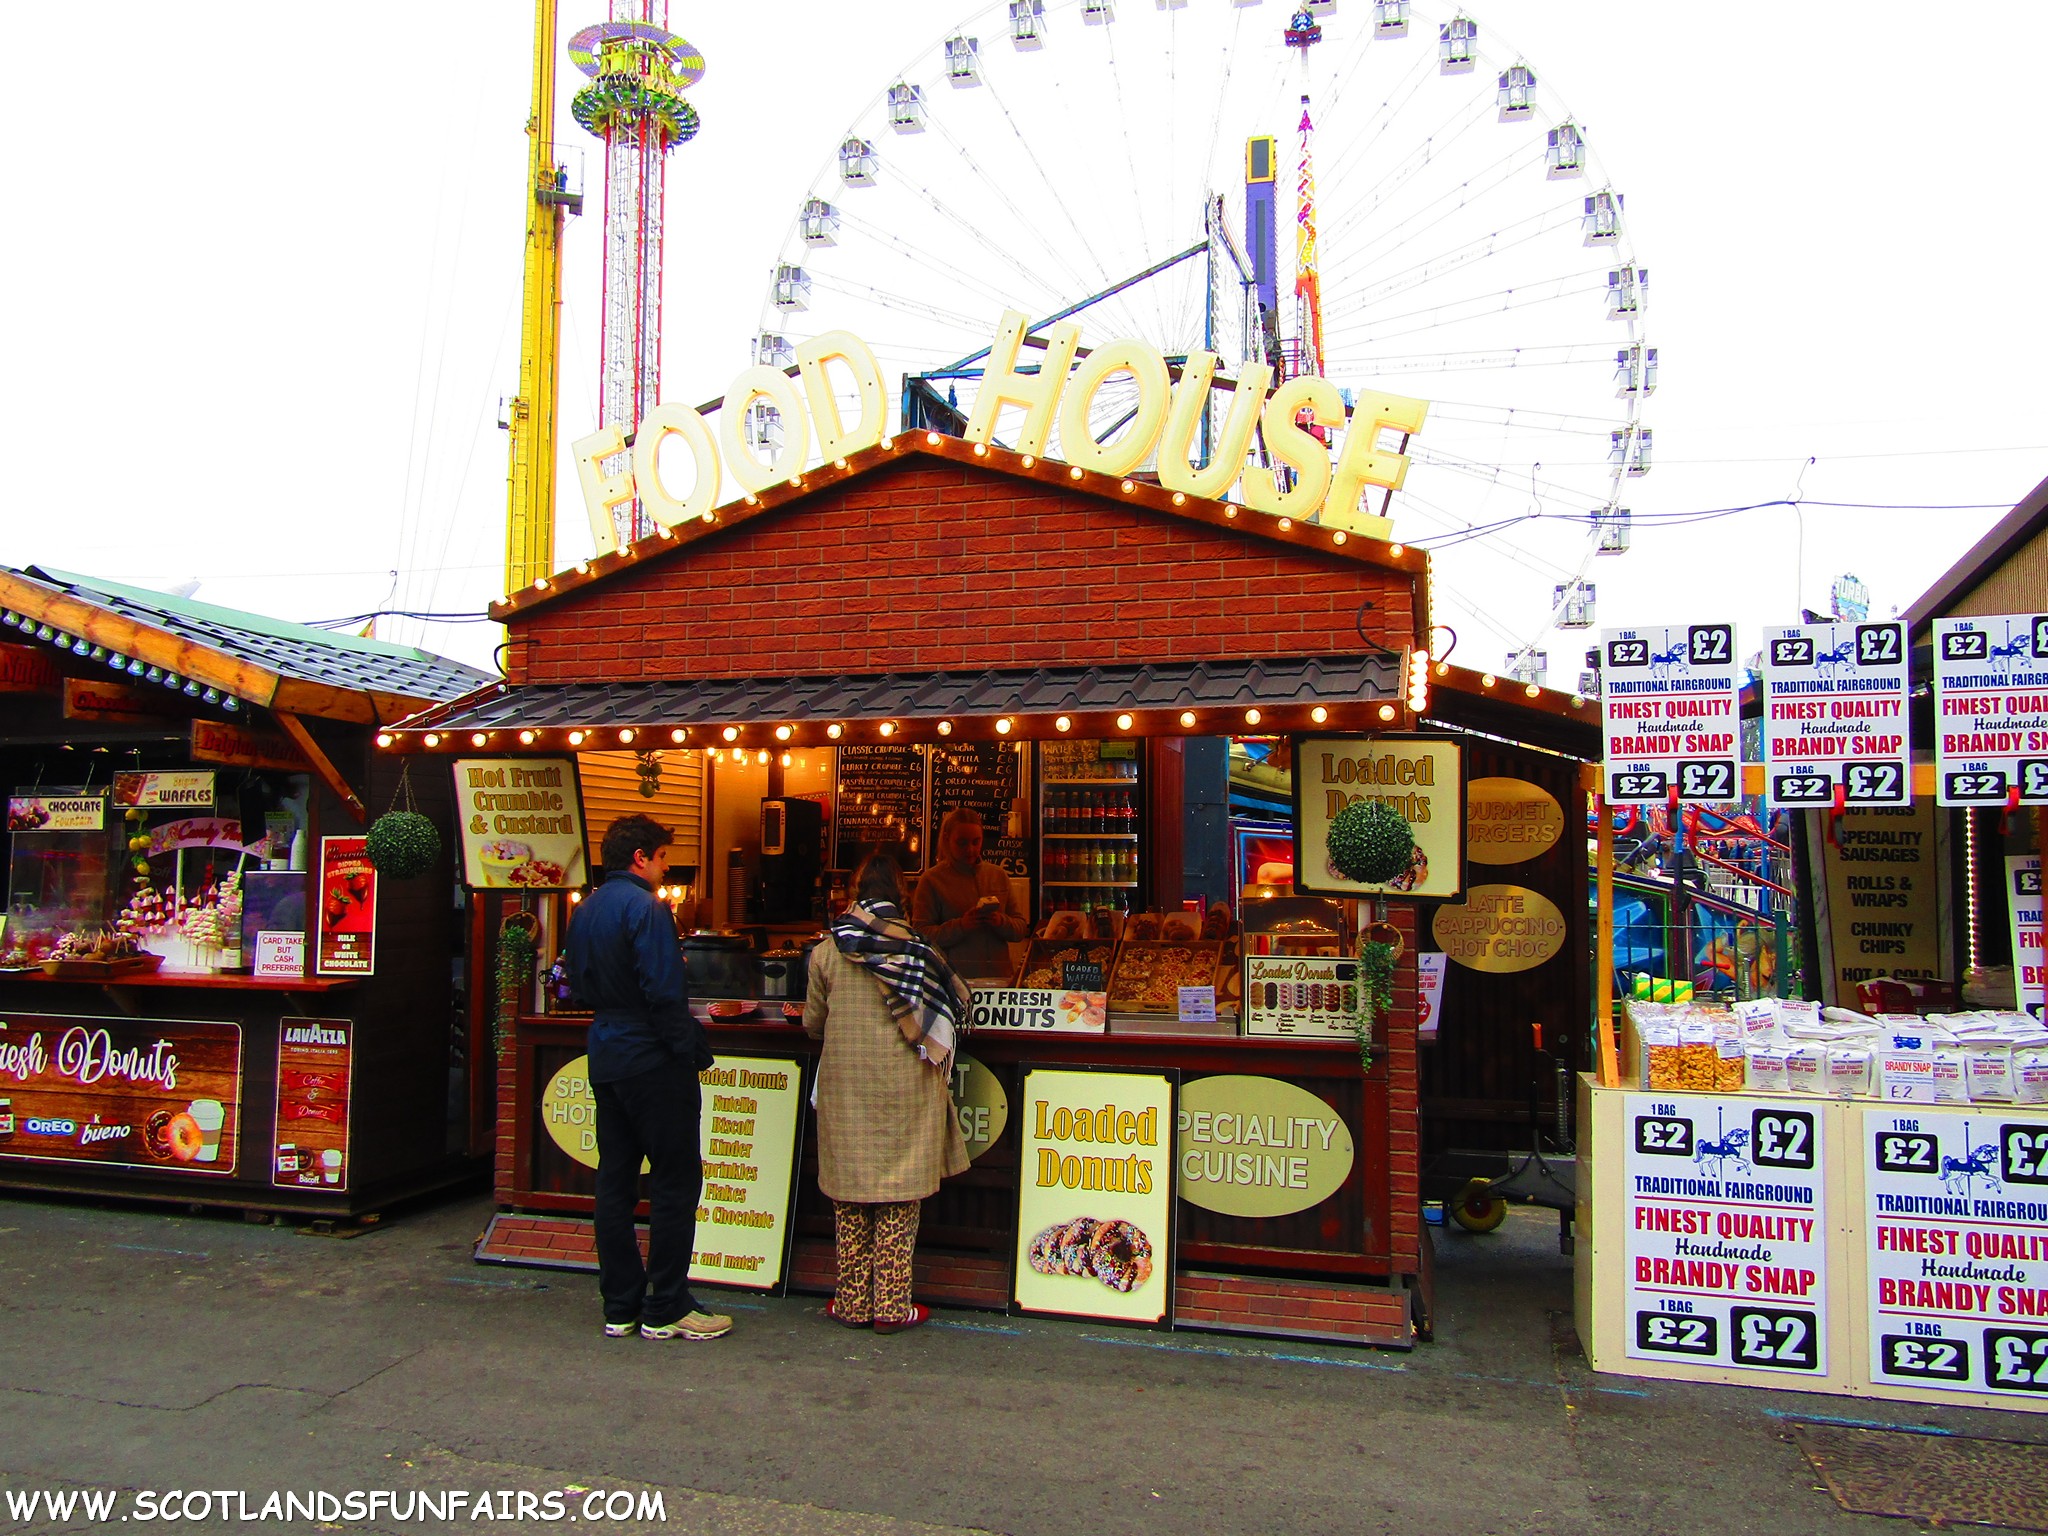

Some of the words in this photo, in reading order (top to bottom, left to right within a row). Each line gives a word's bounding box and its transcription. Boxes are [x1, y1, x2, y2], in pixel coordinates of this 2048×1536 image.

[570, 329, 888, 557] FOOD
[966, 309, 1431, 543] HOUSE
[1834, 576, 1869, 606] TURBO
[1959, 622, 1974, 631] BAG
[1613, 643, 1644, 662] £2
[1624, 631, 1637, 639] BAG
[1692, 628, 1727, 661] £2
[1776, 642, 1809, 661] £2
[1787, 630, 1801, 638] BAG
[1859, 627, 1897, 661] £2
[1948, 635, 1982, 656] £2
[1608, 680, 1669, 693] TRADITIONAL
[1670, 677, 1732, 691] FAIRGROUND
[1771, 679, 1834, 694] TRADITIONAL
[1836, 677, 1900, 691] FAIRGROUND
[1942, 674, 2009, 689] TRADITIONAL
[1609, 702, 1662, 719] FINEST
[1665, 699, 1732, 718] QUALITY
[1771, 702, 1828, 720] FINEST
[1830, 699, 1901, 720] QUALITY
[1943, 697, 2001, 715] FINEST
[2006, 695, 2048, 715] QUAL
[1637, 720, 1704, 733] Handmade
[1800, 721, 1871, 734] Handmade
[1974, 716, 2047, 731] Handmade
[1610, 735, 1682, 754] BRANDY
[1686, 733, 1734, 753] SNAP
[1772, 737, 1848, 755] BRANDY
[1852, 735, 1903, 754] SNAP
[1943, 732, 2023, 753] BRANDY
[909, 762, 922, 772] £6
[996, 754, 1014, 764] £6
[1970, 762, 1988, 772] BAG
[467, 767, 507, 788] Hot
[509, 766, 562, 788] Fruit
[995, 765, 1013, 775] £6
[1321, 753, 1435, 786] Loaded
[910, 778, 922, 788] £6
[1619, 776, 1662, 795] £2
[1632, 764, 1650, 772] BAG
[1682, 764, 1730, 796] £2
[1781, 778, 1826, 797] £2
[1795, 766, 1814, 774] BAG
[1847, 766, 1898, 797] £2
[1953, 775, 1999, 796] £2
[159, 789, 212, 803] WAFFLES
[473, 790, 563, 812] Crumble
[48, 801, 101, 812] CHOCOLATE
[1467, 801, 1550, 821] OURMET
[177, 820, 220, 846] Candy
[469, 815, 488, 835] &
[494, 814, 574, 835] Custard
[1467, 823, 1557, 843] URGERS
[1839, 848, 1920, 863] SAUSAGES
[1000, 858, 1028, 875] £5
[1847, 876, 1895, 891] ROLLS
[1900, 876, 1912, 891] &
[1467, 895, 1525, 914] LATTE
[1851, 893, 1908, 908] WRAPS
[1436, 916, 1560, 936] CAPPUCCINO
[1851, 922, 1914, 937] CHUNKY
[262, 937, 284, 946] CARD
[286, 938, 305, 946] TAKE
[276, 946, 292, 954] BUT
[1451, 939, 1490, 957] HOT
[1493, 939, 1550, 958] CHOC
[1859, 939, 1906, 955] CHIPS
[261, 964, 304, 972] PREFERRED
[274, 955, 294, 963] CASH
[324, 960, 368, 968] CHOCOLATE
[1065, 963, 1099, 974] LOADED
[1251, 961, 1293, 980] Loaded
[1294, 961, 1335, 980] Donuts
[1842, 967, 1871, 983] HOT
[972, 990, 995, 1005] OT
[998, 991, 1053, 1007] FRESH
[973, 1006, 1056, 1028] ONUTS
[285, 1023, 347, 1046] LAVAZZA
[0, 1031, 48, 1081] resh
[58, 1026, 180, 1091] Donuts
[1884, 1060, 1912, 1072] BRANDY
[1912, 1060, 1932, 1073] SNAP
[302, 1074, 326, 1088] Coffee
[698, 1068, 737, 1088] aded
[739, 1069, 789, 1091] Donuts
[298, 1105, 328, 1118] Donuts
[552, 1102, 597, 1126] HOT
[713, 1094, 758, 1115] Nutella
[27, 1119, 75, 1133] OREO
[711, 1116, 756, 1137] Biscoff
[1034, 1100, 1159, 1147] Loaded
[1178, 1108, 1340, 1151] PECIALITY
[1657, 1103, 1676, 1117] BAG
[1758, 1118, 1807, 1161] £2
[1899, 1120, 1919, 1132] BAG
[81, 1123, 131, 1145] bueno
[1642, 1121, 1687, 1149] £2
[709, 1138, 754, 1158] Kinder
[1884, 1137, 1931, 1166] £2
[1036, 1147, 1153, 1195] Donuts
[1181, 1148, 1309, 1189] CUISINE
[705, 1182, 747, 1203] Flakes
[1635, 1175, 1722, 1198] TRADITIONAL
[1724, 1181, 1813, 1204] FAIRGROUND
[712, 1206, 775, 1229] Chocolate
[1876, 1194, 1971, 1217] TRADITIONAL
[1974, 1199, 2048, 1221] FAIRGROU
[1635, 1206, 1712, 1234] FINEST
[1717, 1212, 1814, 1243] QUALITY
[1675, 1237, 1773, 1262] Handmade
[1877, 1226, 1959, 1256] FINEST
[1966, 1231, 2048, 1262] QUALIT
[700, 1252, 723, 1267] and
[1635, 1256, 1739, 1289] BRANDY
[1746, 1266, 1816, 1296] SNAP
[1921, 1258, 2027, 1283] Handmade
[1879, 1277, 1991, 1313] BRANDY
[1997, 1286, 2048, 1317] SNA
[1647, 1318, 1708, 1347] £2
[1667, 1300, 1693, 1314] BAG
[1740, 1313, 1807, 1362] £2
[1915, 1322, 1942, 1337] BAG
[1893, 1340, 1958, 1372] £2
